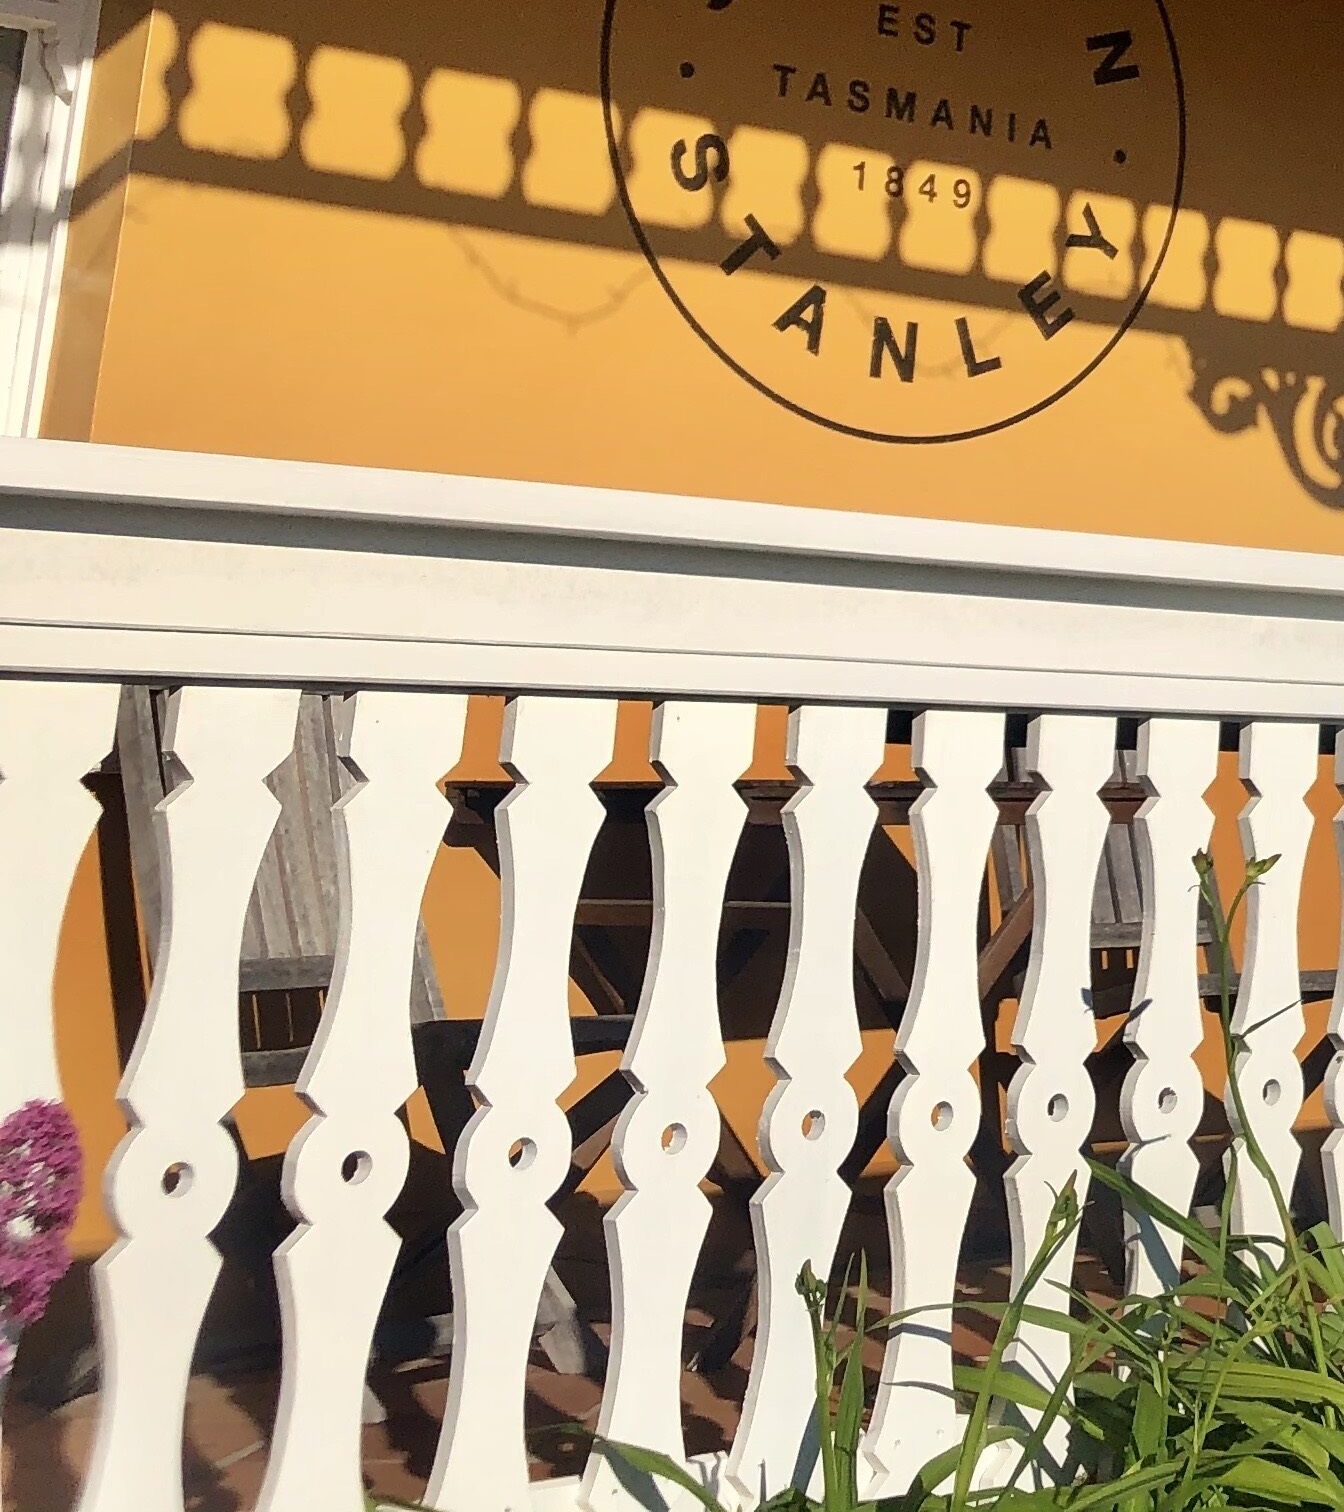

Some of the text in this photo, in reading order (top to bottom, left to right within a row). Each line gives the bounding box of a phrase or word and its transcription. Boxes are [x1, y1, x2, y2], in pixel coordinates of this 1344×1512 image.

[877, 3, 973, 53] EST
[772, 63, 1052, 149] TASMANIA
[851, 160, 973, 209] 1849
[670, 132, 1119, 383] STANLEY
